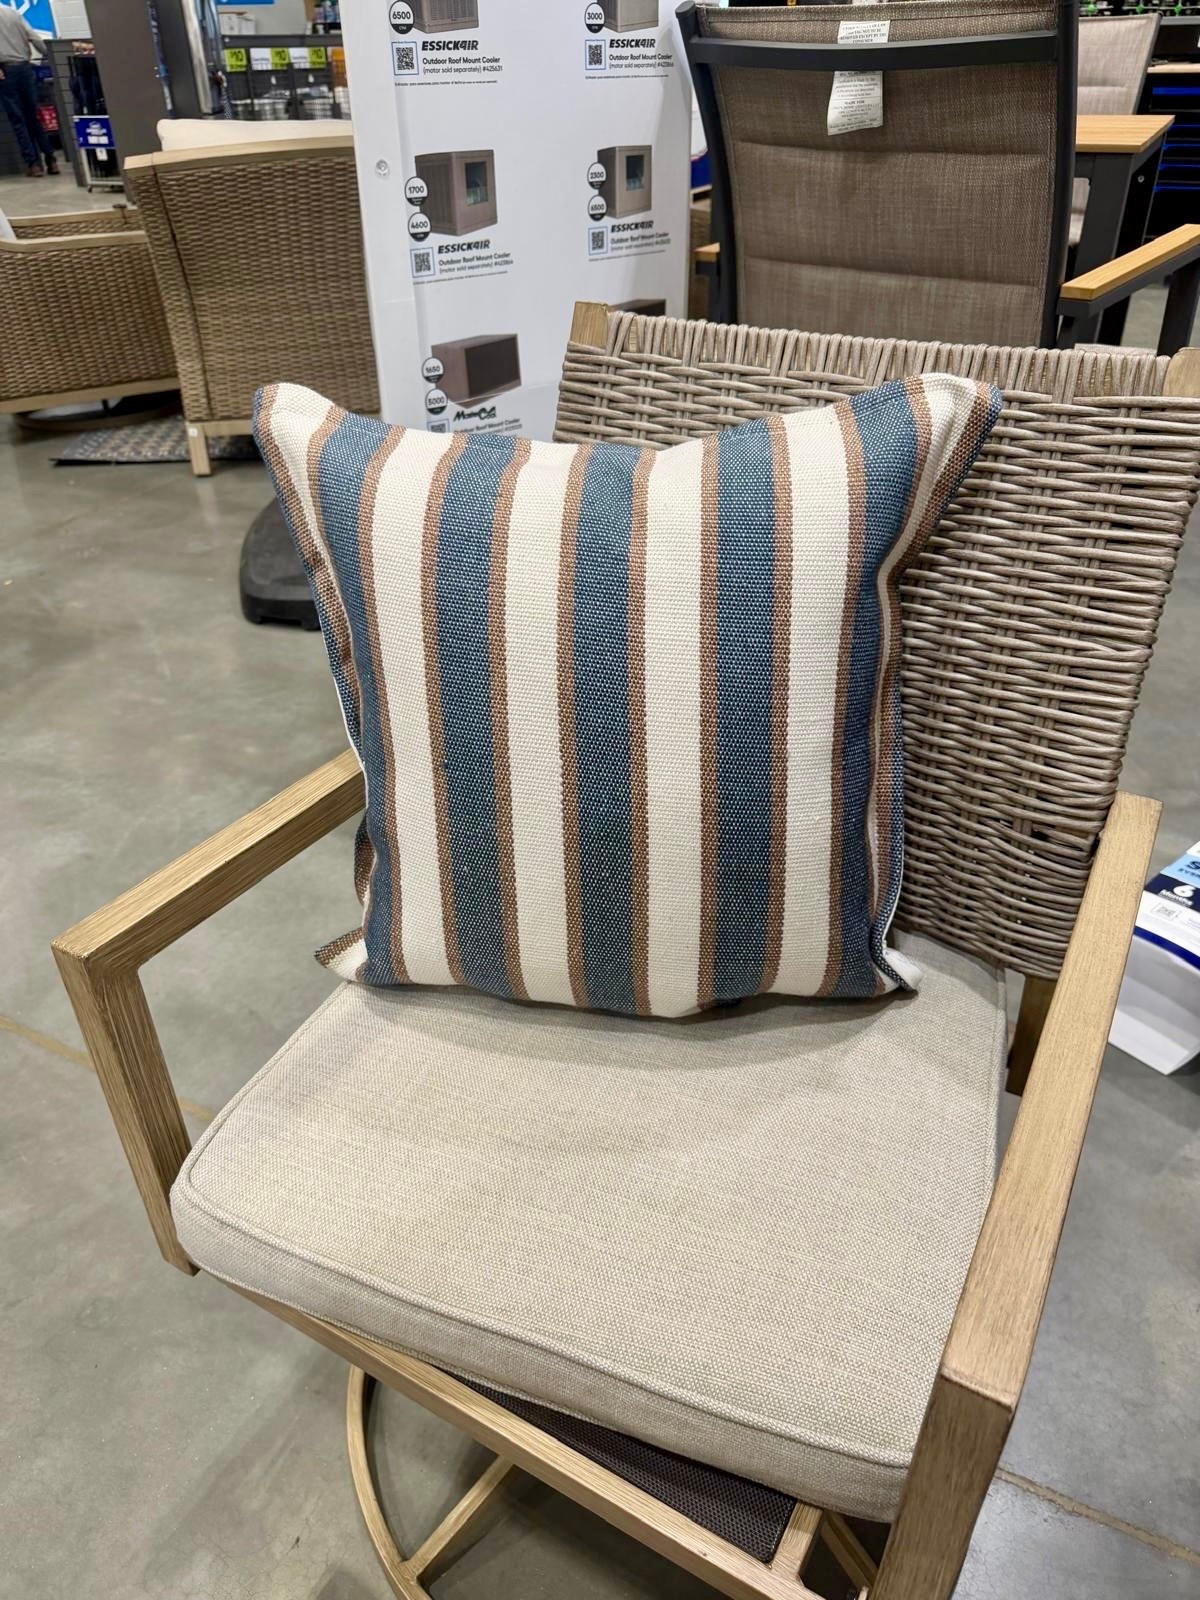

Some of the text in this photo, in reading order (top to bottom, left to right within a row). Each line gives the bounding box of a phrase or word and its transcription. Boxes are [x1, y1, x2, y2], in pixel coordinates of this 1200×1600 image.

[392, 11, 411, 20] 6500
[587, 12, 602, 20] 3000
[422, 57, 447, 65] Outdoor
[462, 56, 481, 64] Mount
[408, 185, 425, 194] 1700
[439, 258, 462, 266] Outdoor
[1173, 884, 1196, 898] 6
